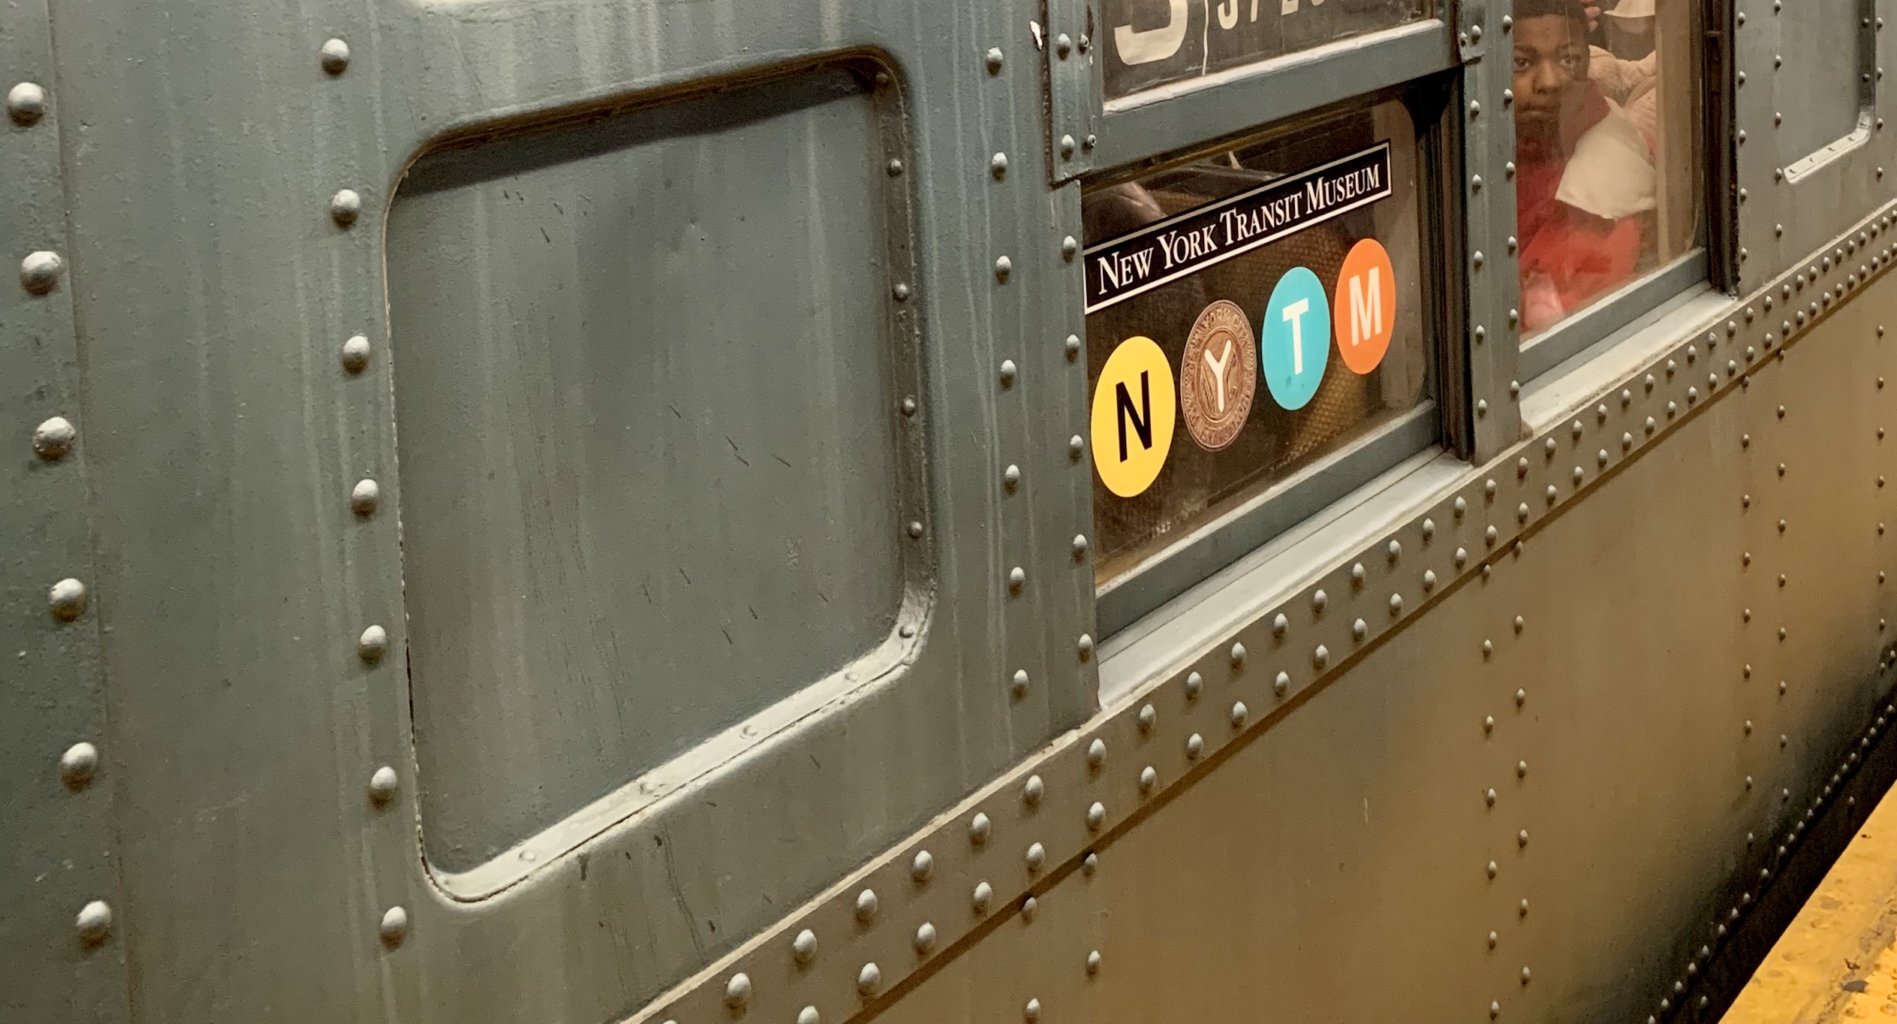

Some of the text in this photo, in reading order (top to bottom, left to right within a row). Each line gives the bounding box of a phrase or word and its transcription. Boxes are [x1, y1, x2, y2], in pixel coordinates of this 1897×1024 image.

[1097, 163, 1381, 295] NEW YORK TRANSIT MUSEUM
[1116, 370, 1153, 463] N
[1204, 339, 1232, 412] Y
[1282, 297, 1309, 376] T
[1349, 266, 1382, 347] M
